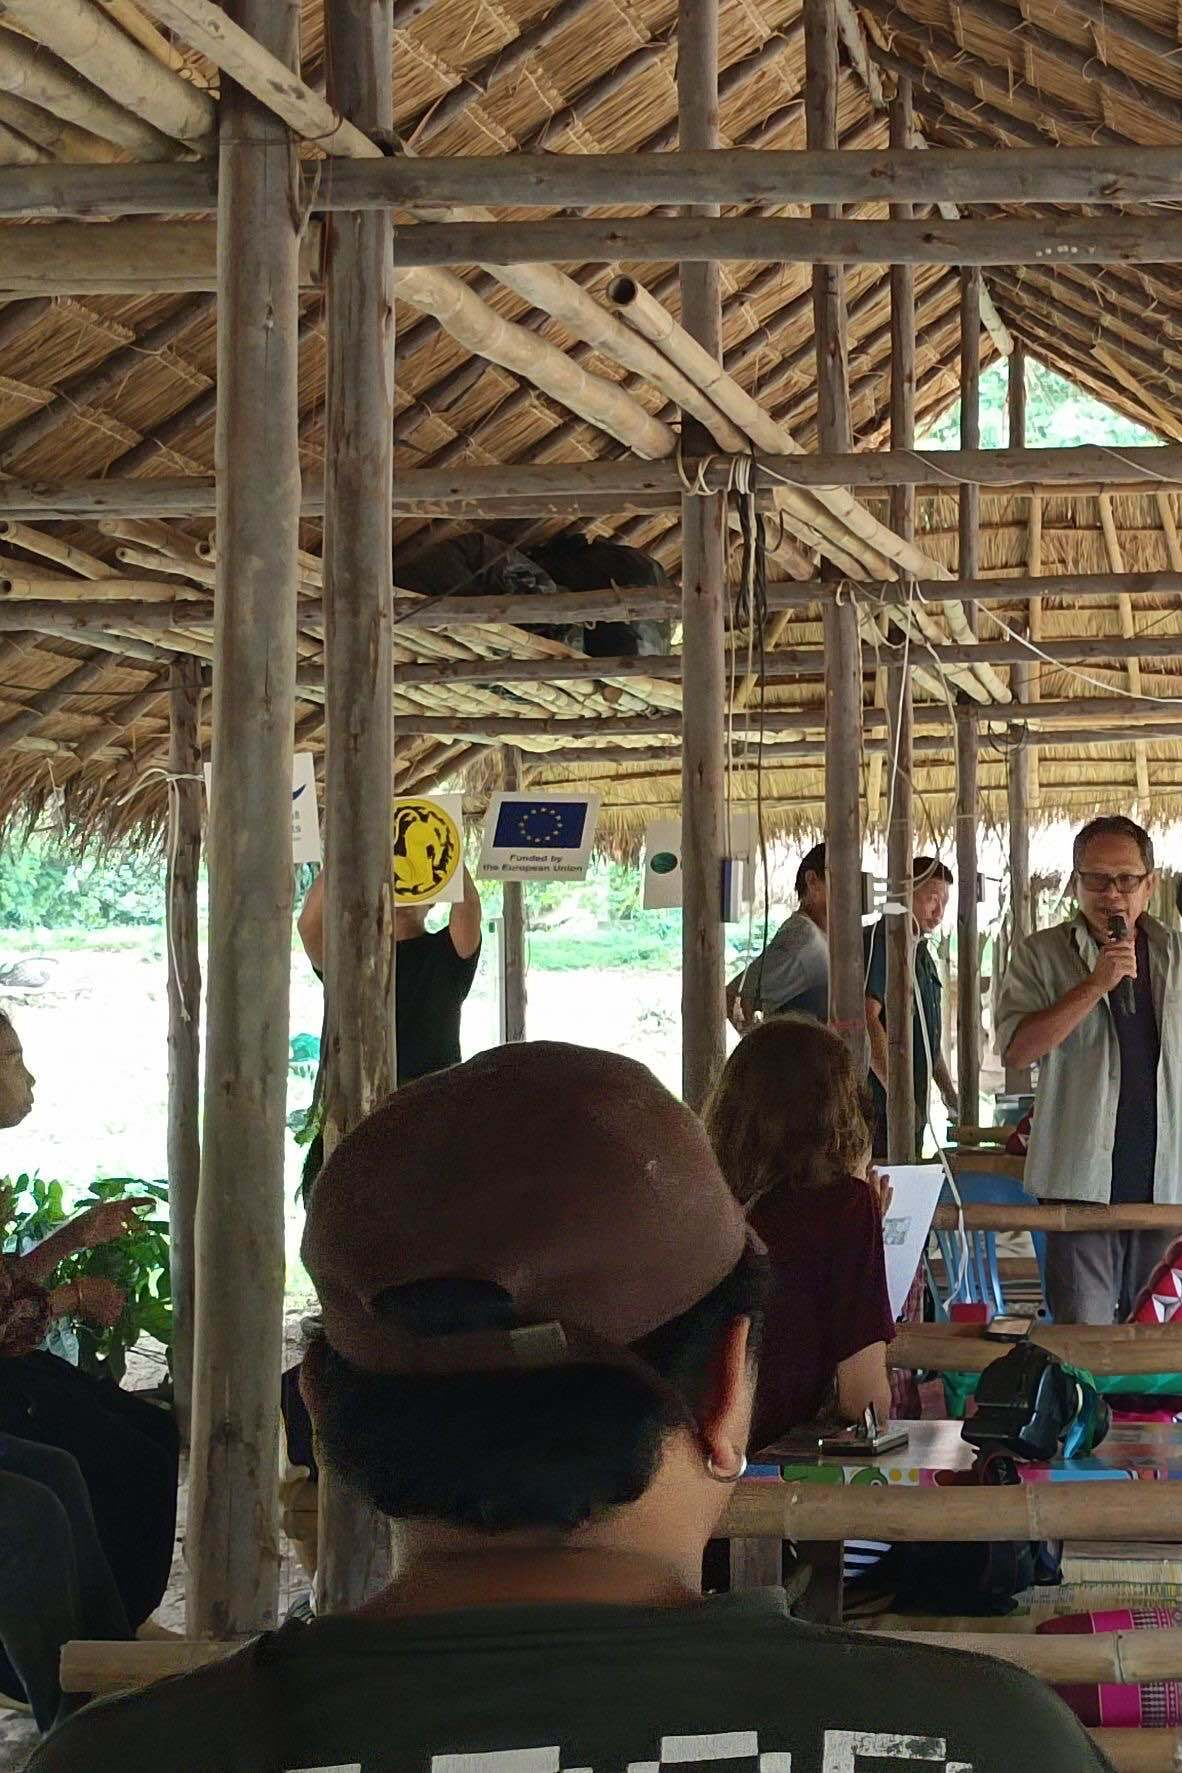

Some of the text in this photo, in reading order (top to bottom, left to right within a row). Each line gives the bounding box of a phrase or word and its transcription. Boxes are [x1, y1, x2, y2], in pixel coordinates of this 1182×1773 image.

[510, 854, 563, 863] Funded by
[501, 863, 550, 872] European
[553, 864, 583, 872] Union
